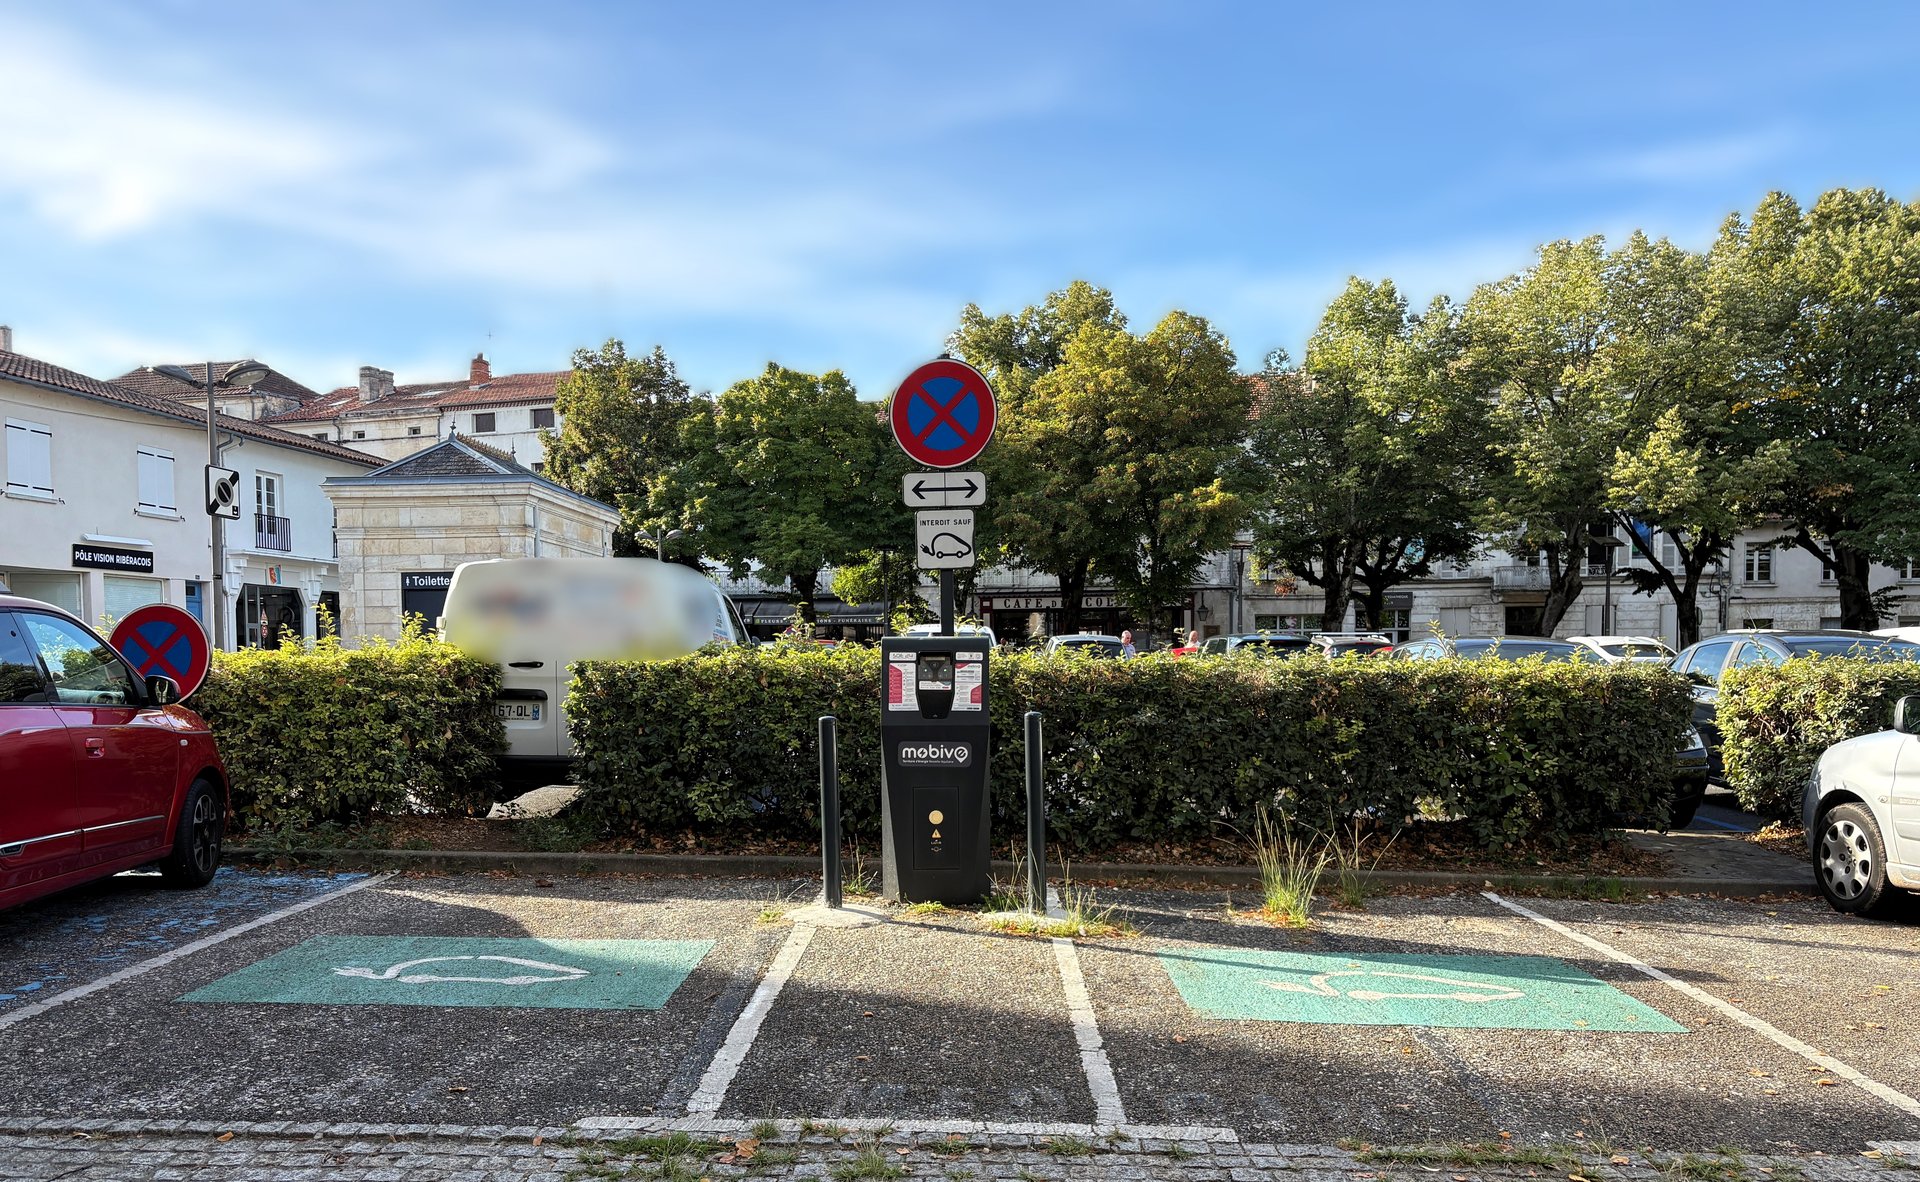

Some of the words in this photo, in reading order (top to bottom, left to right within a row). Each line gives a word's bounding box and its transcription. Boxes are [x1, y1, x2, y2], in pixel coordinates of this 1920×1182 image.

[953, 518, 971, 526] SAUF
[75, 549, 92, 561] PÔLE
[93, 552, 115, 564] VISION
[412, 575, 451, 586] Toilette
[1003, 598, 1043, 608] CAFE
[902, 744, 968, 763] mobive
